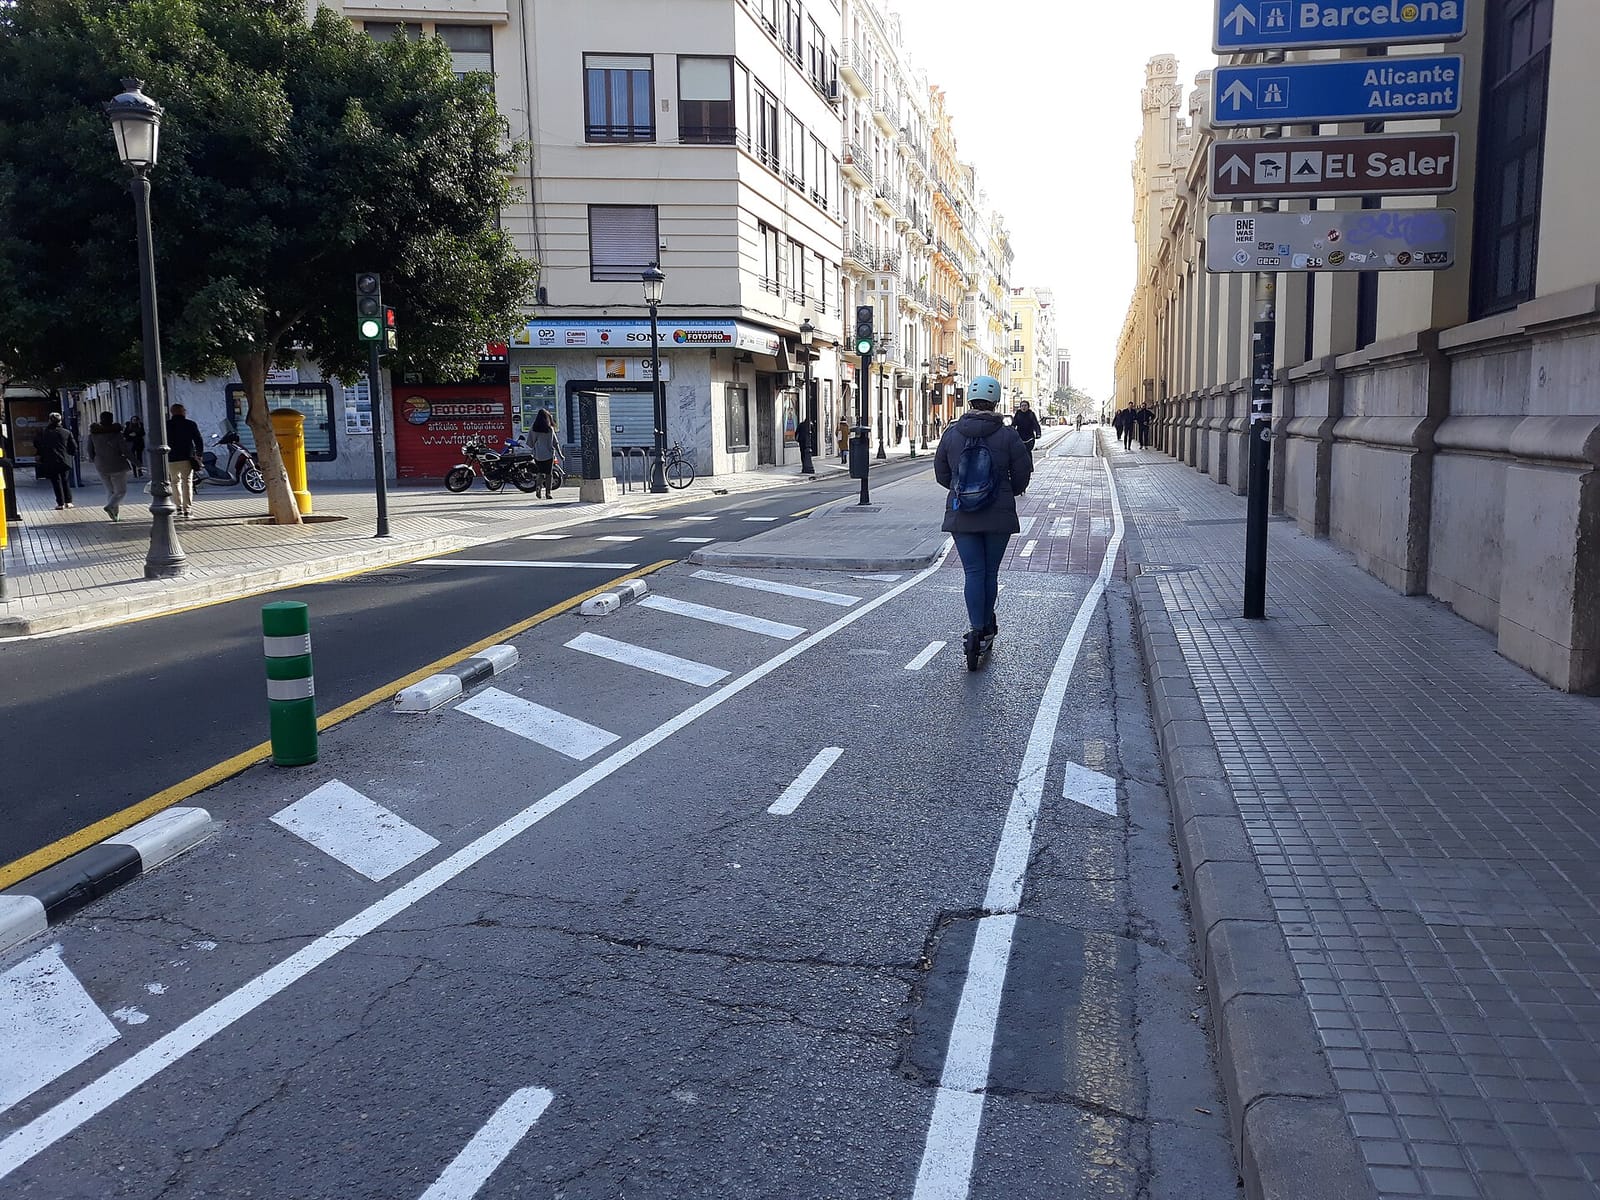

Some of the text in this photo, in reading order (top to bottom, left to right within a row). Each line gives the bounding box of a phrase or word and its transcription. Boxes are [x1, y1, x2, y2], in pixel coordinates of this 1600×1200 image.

[1301, 0, 1458, 28] Barcelona
[1363, 65, 1455, 86] Alicante
[1368, 87, 1453, 107] Alacant
[1325, 151, 1450, 178] El Saler
[1236, 219, 1254, 230] BNE
[434, 404, 492, 415] FOTOPRO
